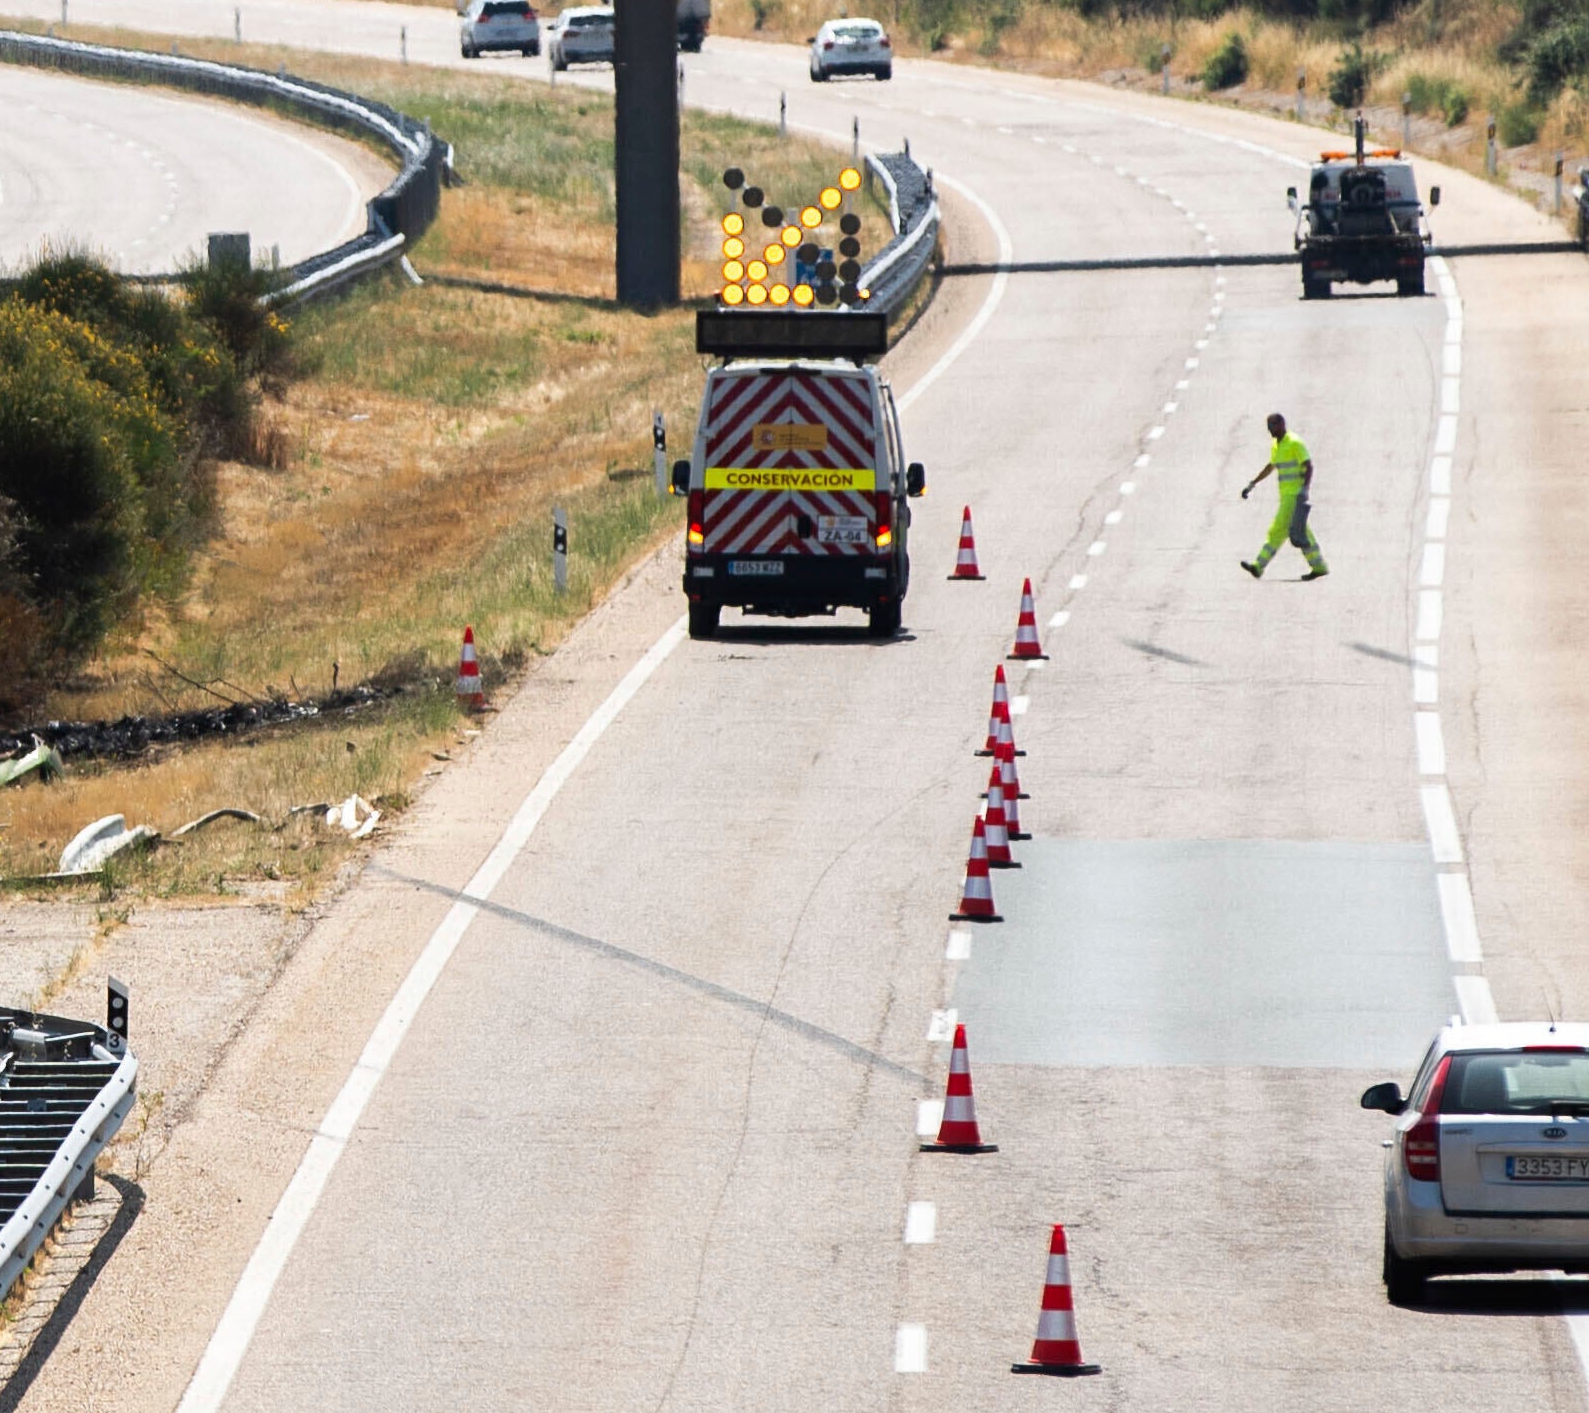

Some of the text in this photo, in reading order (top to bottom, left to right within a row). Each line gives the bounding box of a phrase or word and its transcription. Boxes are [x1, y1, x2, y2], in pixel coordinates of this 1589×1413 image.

[726, 470, 853, 486] CONSERVACIÓN
[109, 1033, 120, 1048] 3
[1517, 1159, 1562, 1175] 3353
